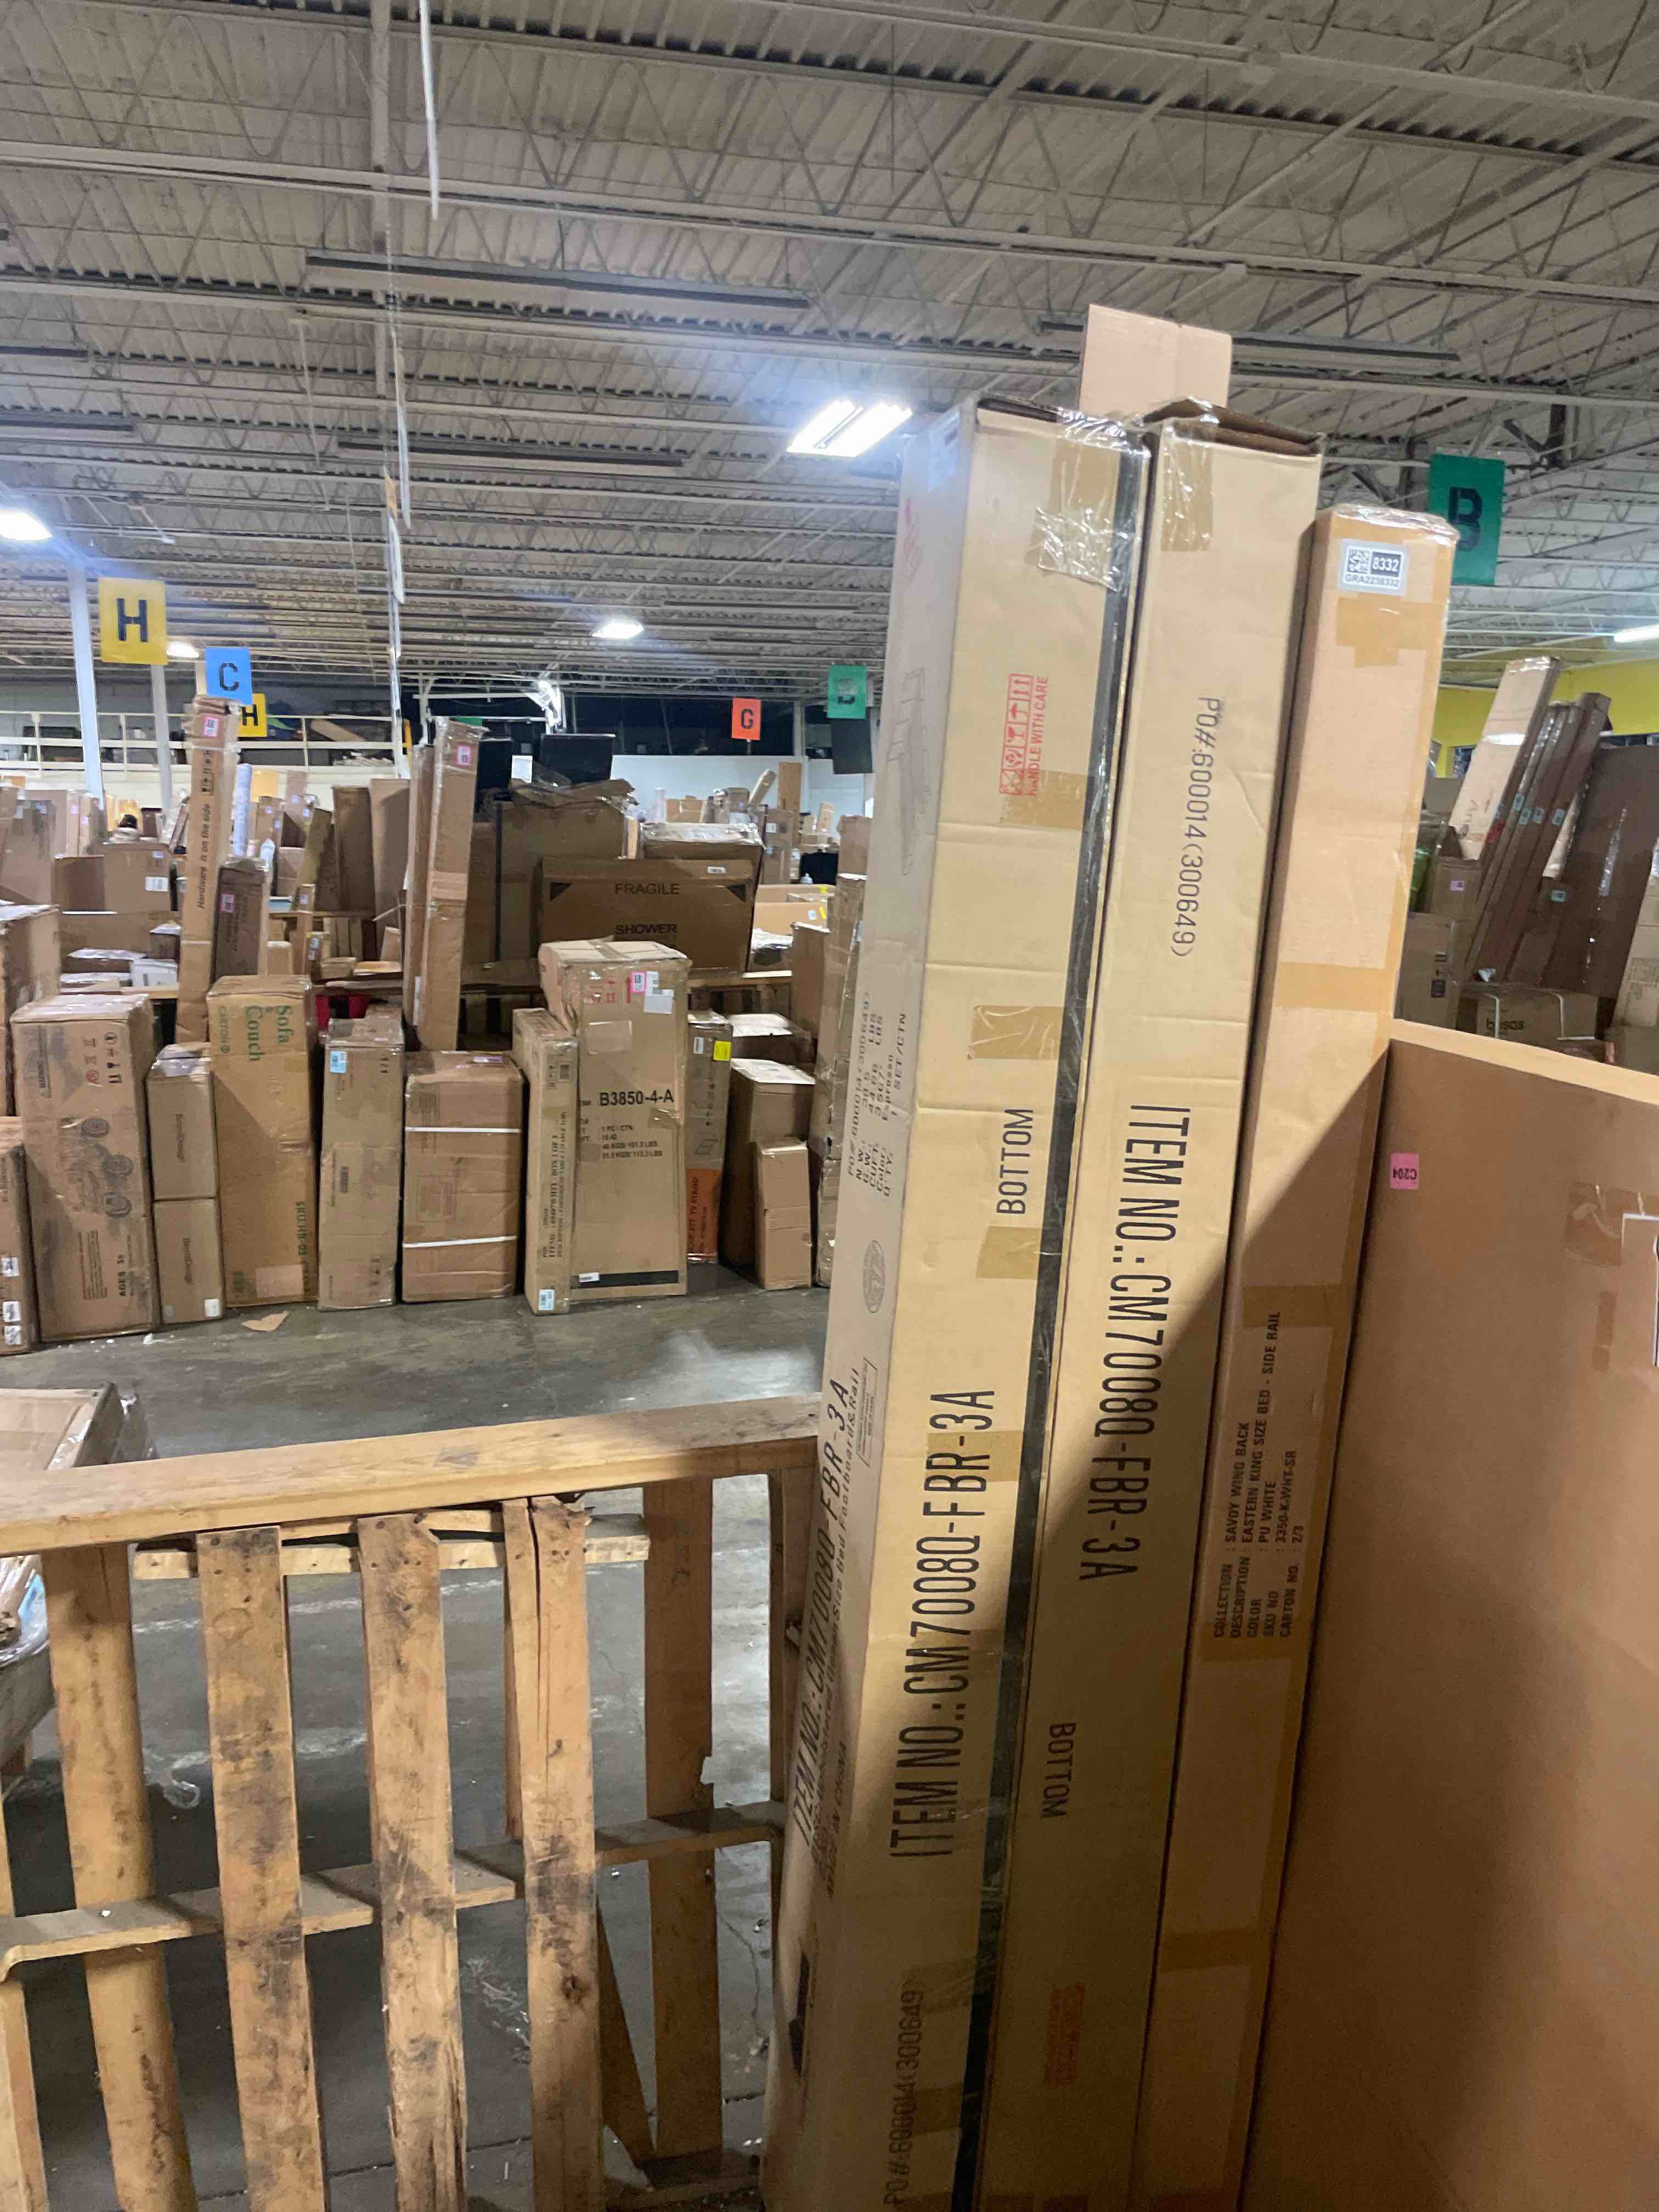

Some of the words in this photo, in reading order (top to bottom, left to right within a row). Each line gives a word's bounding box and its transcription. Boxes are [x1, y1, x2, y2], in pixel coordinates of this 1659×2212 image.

[1449, 487, 1482, 551] B
[1372, 557, 1399, 572] 8332
[117, 597, 149, 642] H
[219, 662, 240, 691] C
[1034, 675, 1049, 712] CARE
[242, 703, 258, 726] H
[740, 708, 754, 730] G
[1031, 713, 1045, 744] WITH
[202, 803, 211, 822] side
[1170, 696, 1221, 957] PO#:600014(300649)
[201, 824, 210, 839] the
[201, 840, 208, 853] on
[198, 867, 207, 909] Hardware
[614, 883, 680, 895] FRAGILE
[614, 923, 677, 935] SHOWER
[245, 1005, 266, 1061] Couch
[276, 1005, 295, 1045] Sofa
[600, 1089, 674, 1107] B3850-4-A
[996, 1108, 1034, 1215] BOTTOM
[1122, 1104, 1191, 1186] ITEM
[1392, 1167, 1418, 1180] C204
[1266, 1311, 1281, 1340] RAIL
[1262, 1345, 1276, 1374] SIDE
[1256, 1390, 1270, 1414] BED
[1235, 1421, 1250, 1457] BACK
[1254, 1419, 1267, 1446] SIZE
[1231, 1461, 1245, 1497] WING
[1249, 1451, 1263, 1481] KING
[1242, 1487, 1259, 1543] EASTERN
[1261, 1481, 1277, 1521] WHITE
[1224, 1502, 1240, 1543] SAVOY
[1259, 1526, 1271, 1543] PU
[837, 1534, 846, 1574] Bed
[1229, 1556, 1250, 1638] DESCRIPTION
[1267, 1590, 1279, 1609] NO
[1280, 1588, 1296, 1638] CARTON
[1291, 1525, 1305, 1543] 2/3
[1214, 1564, 1233, 1638] COLLECTION
[1246, 1598, 1261, 1638] COLOR
[1263, 1613, 1276, 1638] SKU
[793, 1747, 816, 1847] ITEM
[890, 1781, 958, 1857] ITEM
